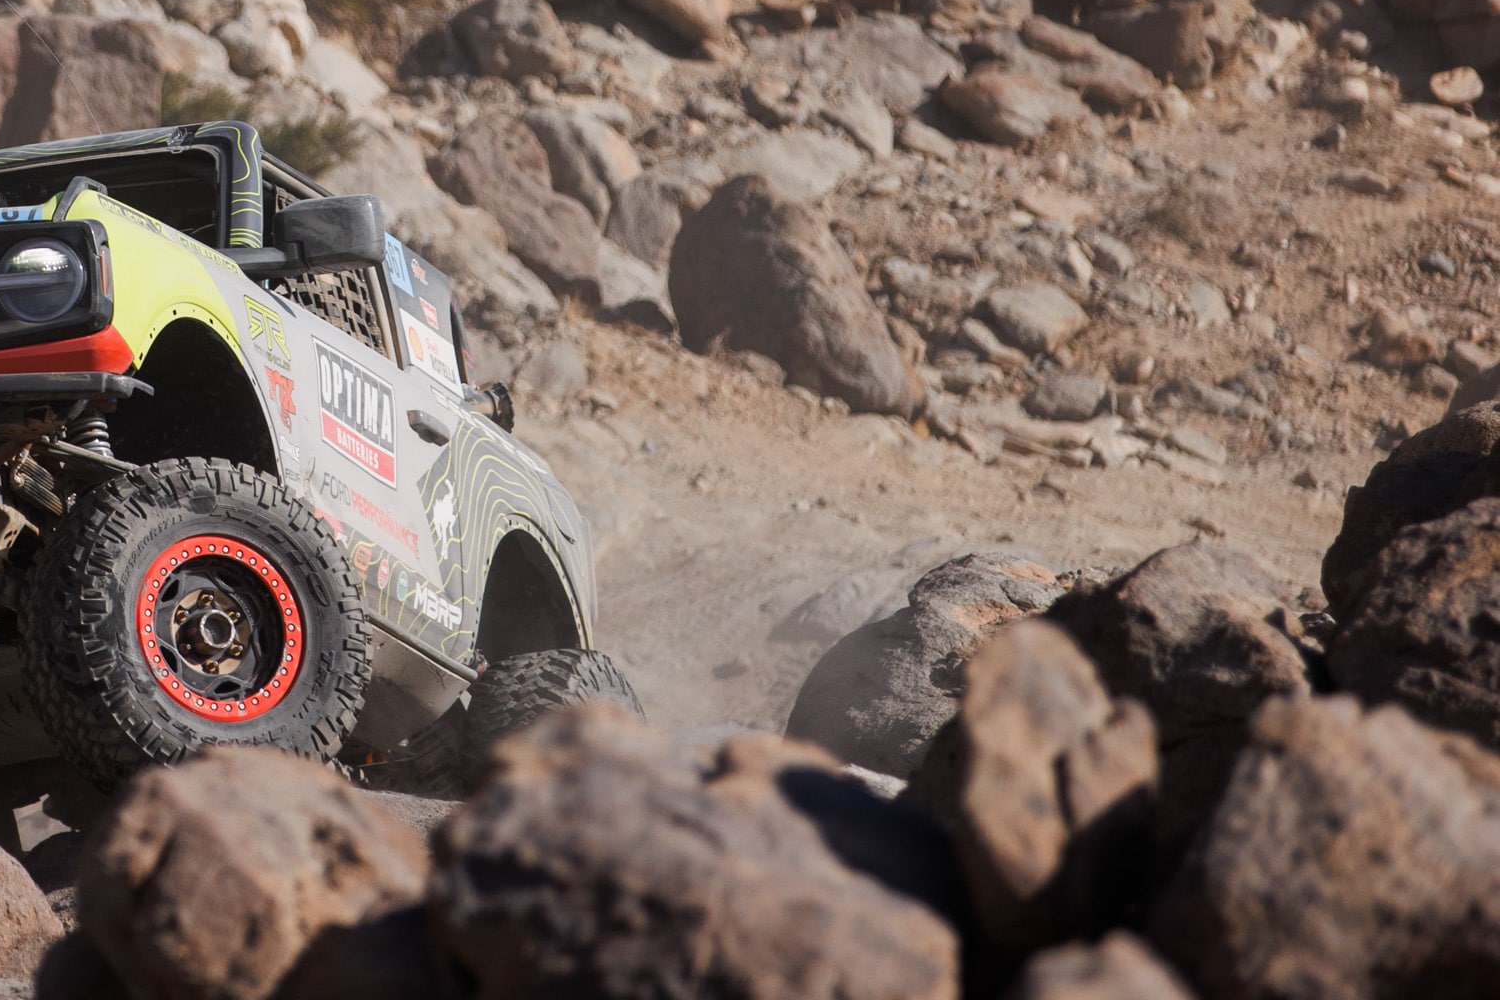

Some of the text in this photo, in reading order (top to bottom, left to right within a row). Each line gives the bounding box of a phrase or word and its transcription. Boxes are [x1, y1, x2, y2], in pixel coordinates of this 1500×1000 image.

[320, 354, 393, 444] OPTIMA
[336, 426, 380, 470] BATTERIES
[320, 472, 352, 506] FORD
[414, 582, 462, 630] MBRP
